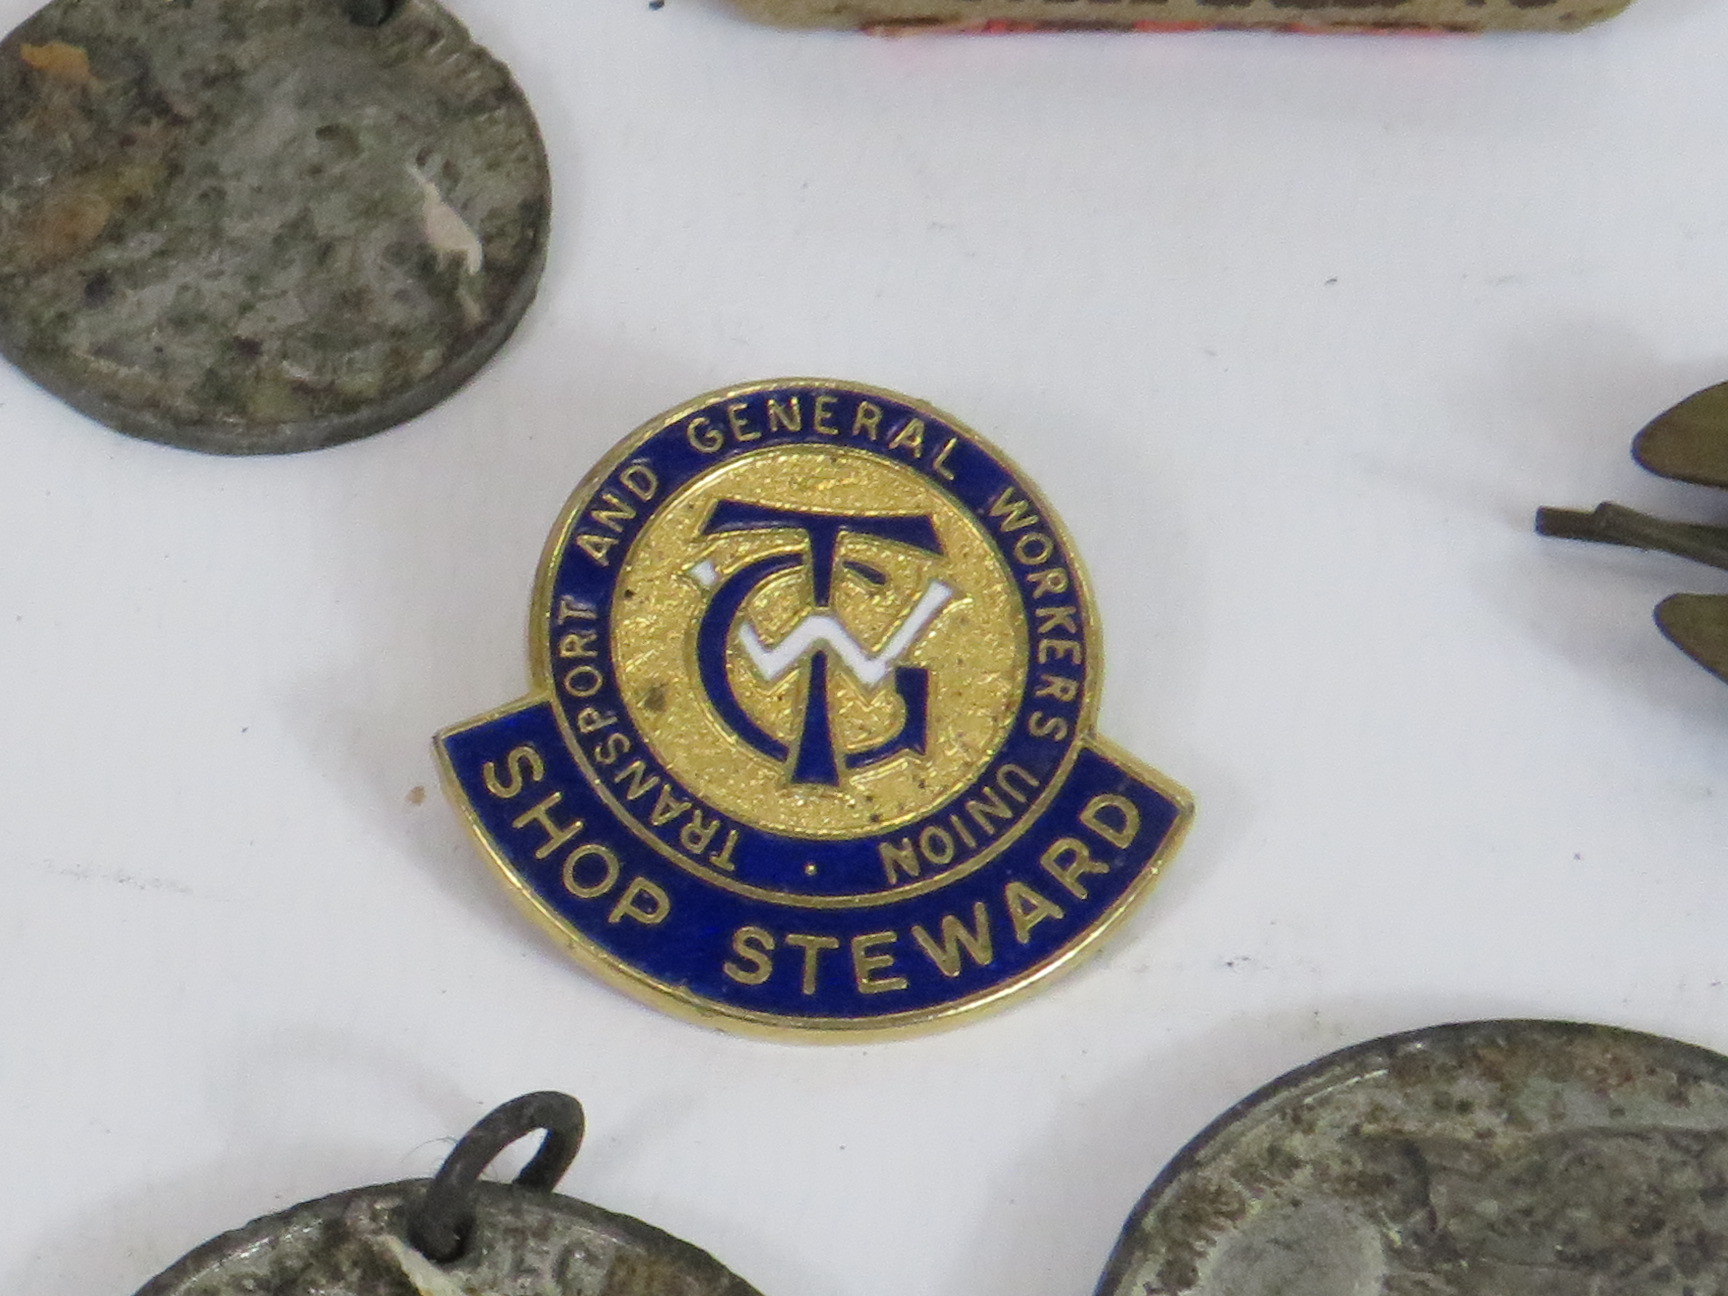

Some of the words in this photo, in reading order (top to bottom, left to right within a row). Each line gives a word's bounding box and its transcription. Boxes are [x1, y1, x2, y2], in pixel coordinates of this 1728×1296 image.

[575, 458, 662, 568] AND
[685, 395, 962, 482] GENERAL
[986, 483, 1084, 745] WORKERS
[558, 592, 739, 875] TRANSPORT
[876, 760, 1042, 886] UNION
[481, 744, 673, 927] SHOP
[722, 789, 1143, 997] STEWARD
